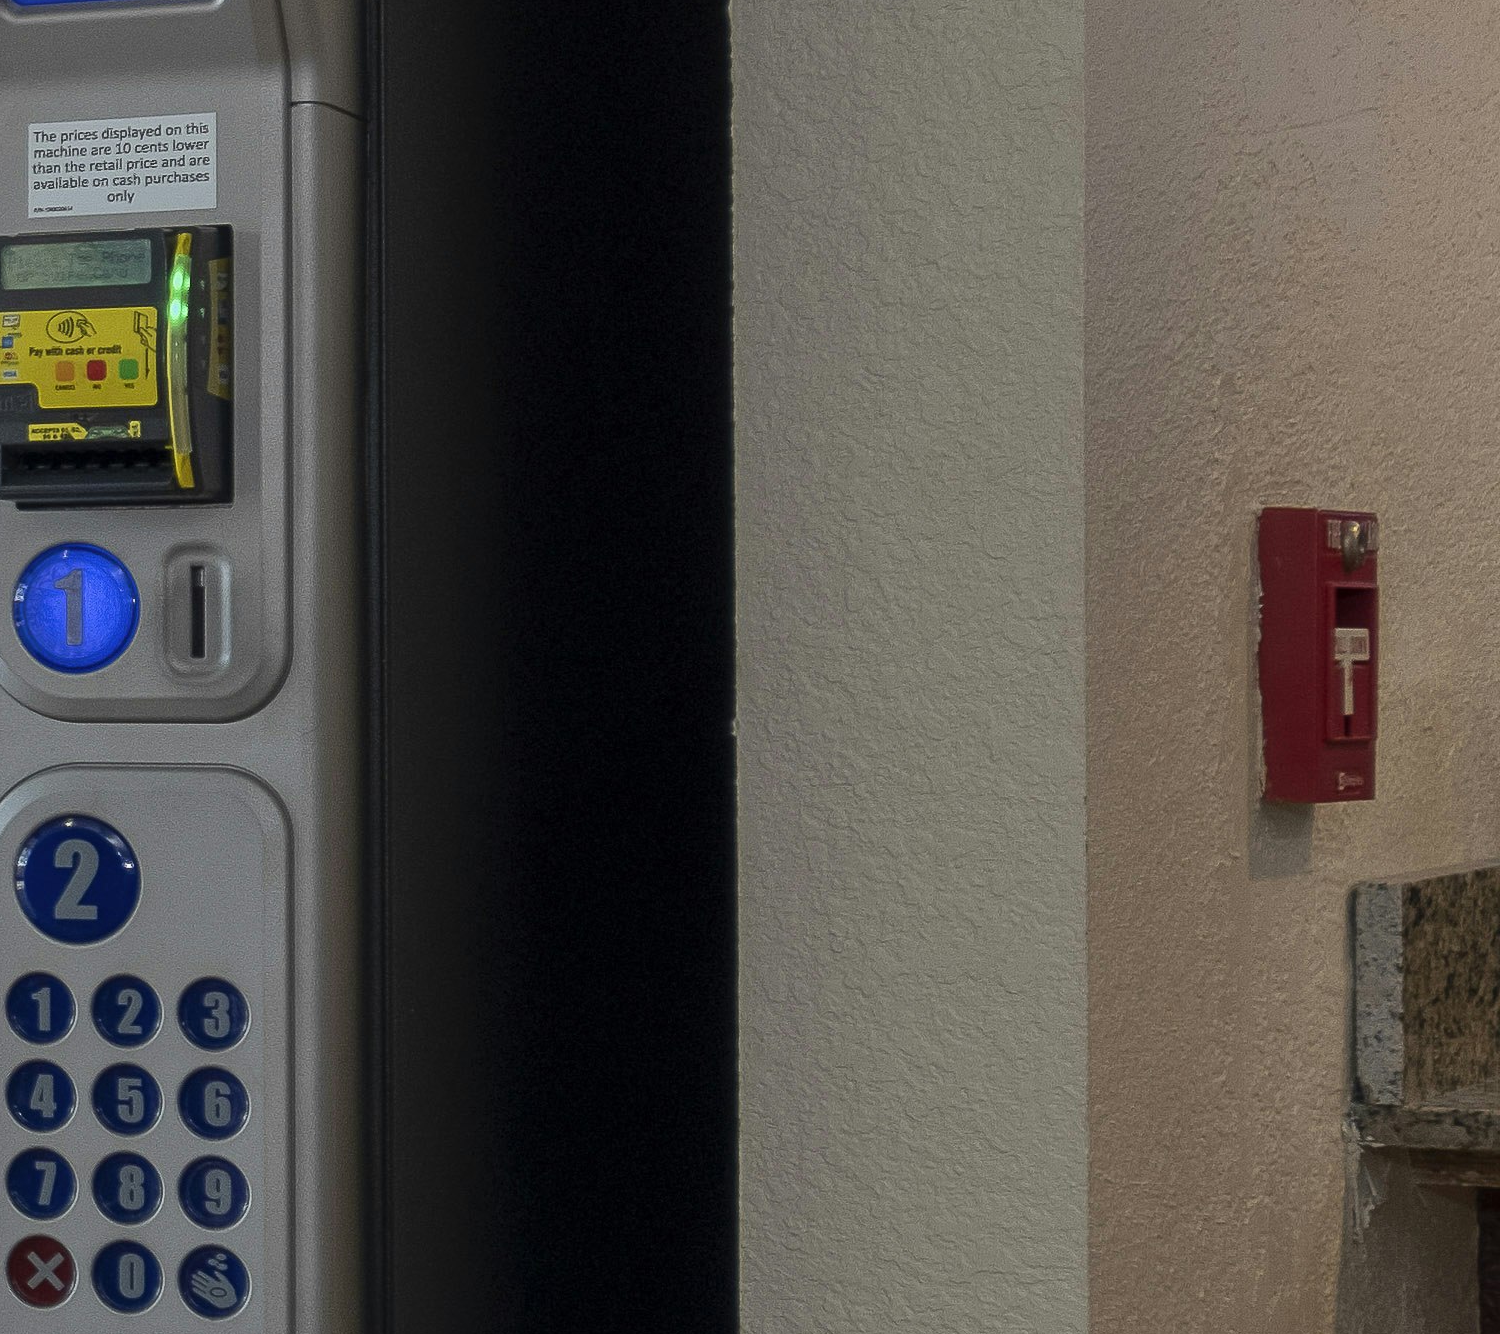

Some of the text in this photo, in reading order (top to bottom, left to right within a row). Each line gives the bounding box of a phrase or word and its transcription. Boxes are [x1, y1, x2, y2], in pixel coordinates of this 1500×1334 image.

[33, 139, 210, 159] machine are 10 cents lower
[34, 123, 210, 146] The prices displayed on this
[32, 154, 211, 175] than the retail price and are
[32, 170, 211, 191] available on cash purchases
[107, 190, 136, 204] only
[46, 346, 63, 356] with
[65, 345, 85, 355] cash
[54, 567, 86, 648] 1
[53, 838, 101, 921] 2
[30, 989, 52, 1032] 1
[116, 990, 143, 1035] 2
[202, 991, 231, 1038] 3
[28, 1077, 57, 1119] 4
[116, 1079, 144, 1124] 5
[203, 1080, 232, 1127] 6
[34, 1161, 56, 1207] 7
[118, 1166, 146, 1212] 8
[203, 1168, 232, 1216] 9
[119, 1254, 145, 1299] 0
